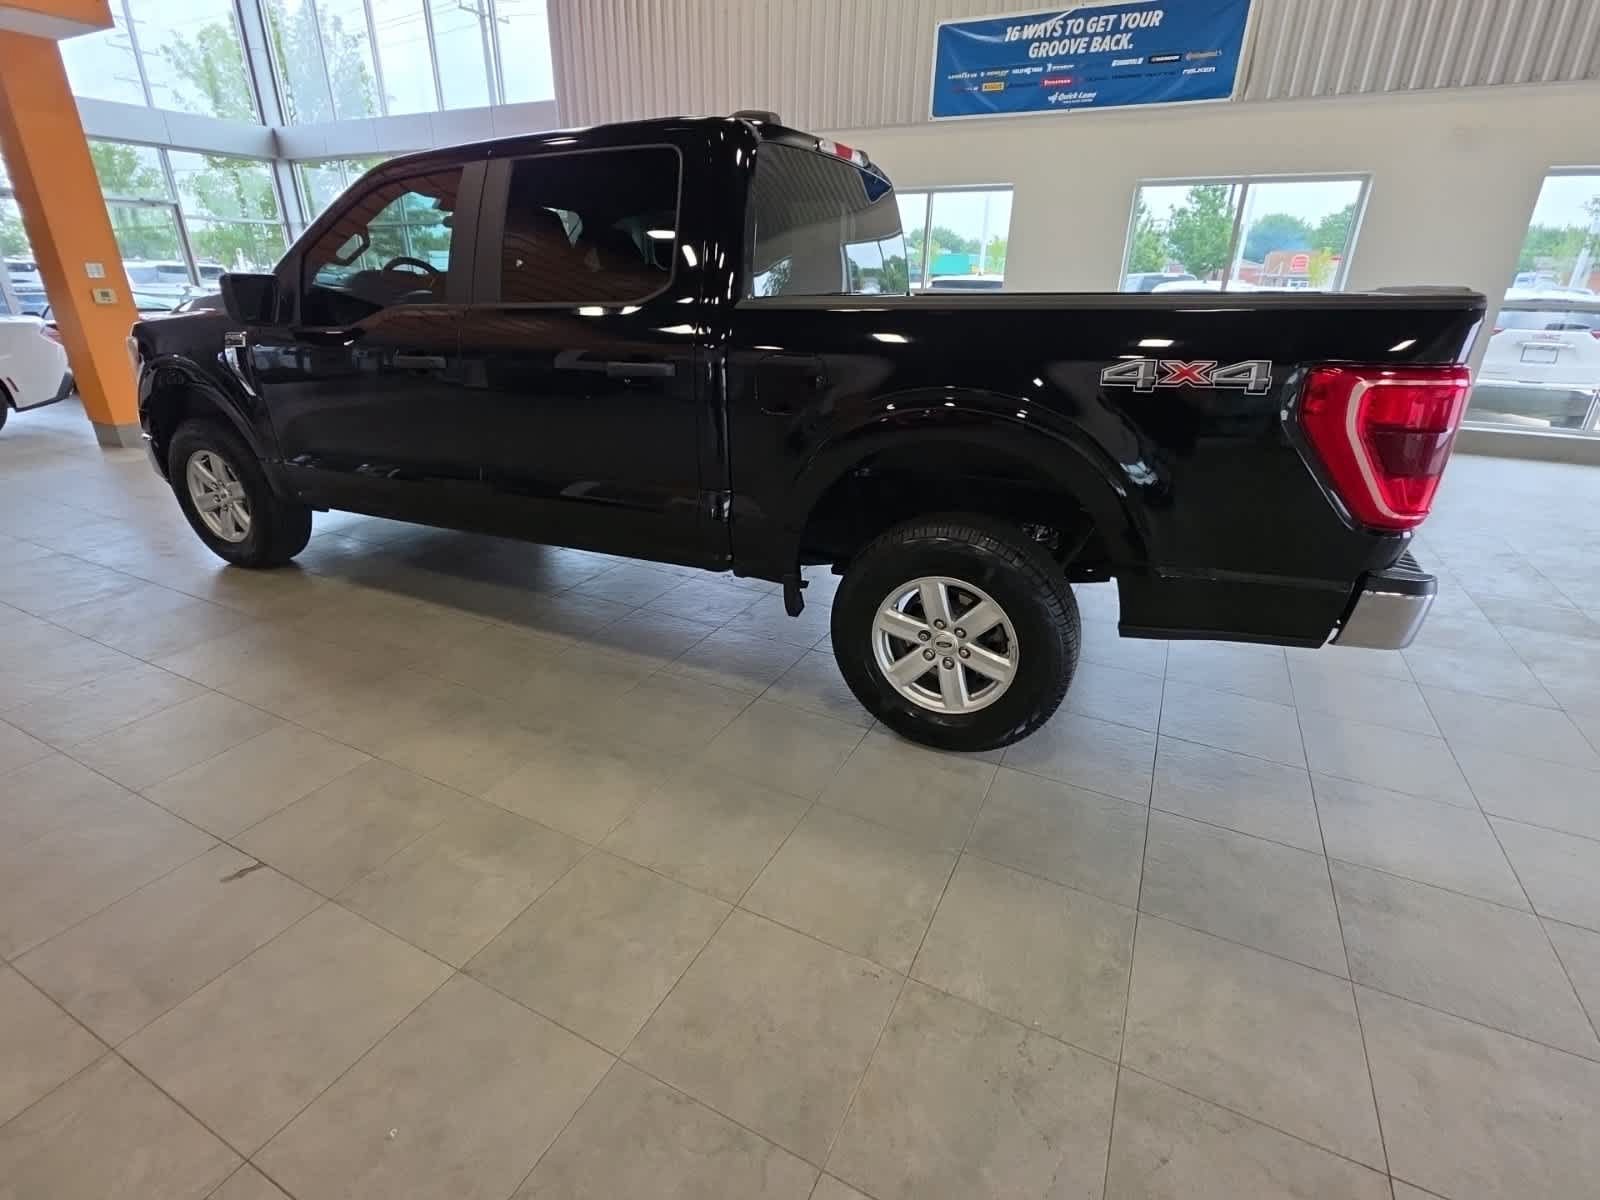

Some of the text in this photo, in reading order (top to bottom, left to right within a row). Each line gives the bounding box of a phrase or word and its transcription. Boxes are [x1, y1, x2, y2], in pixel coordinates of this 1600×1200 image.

[1004, 9, 1164, 43] 16 WAYS TO GET YOUR
[1028, 32, 1135, 59] GROOVE BACK.
[1079, 91, 1097, 100] Lane
